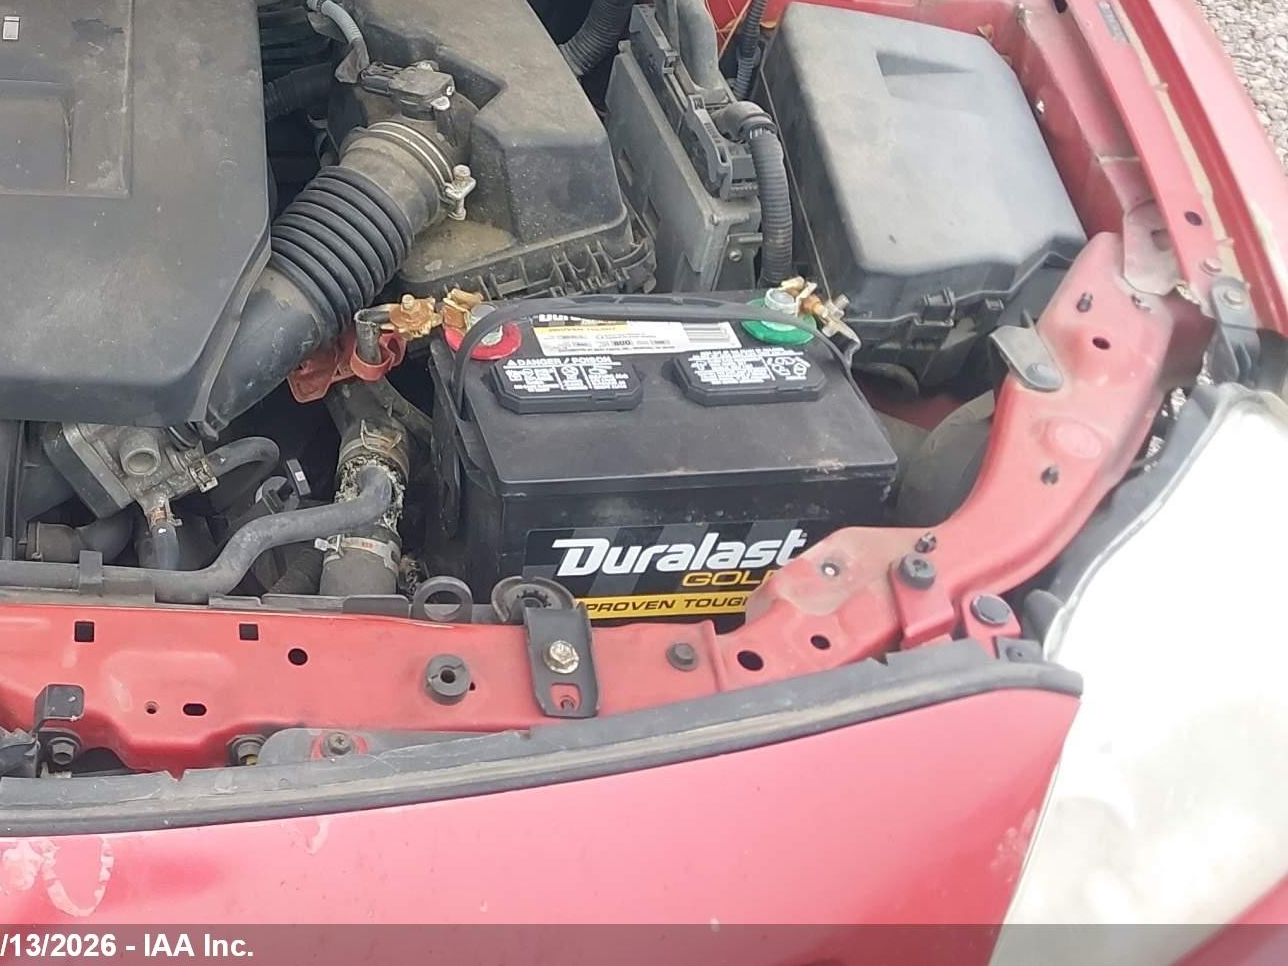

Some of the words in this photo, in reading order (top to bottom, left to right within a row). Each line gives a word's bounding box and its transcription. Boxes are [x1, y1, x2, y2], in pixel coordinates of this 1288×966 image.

[516, 357, 562, 367] DANGER
[571, 355, 612, 365] POISON
[551, 529, 807, 577] Duralast
[684, 596, 748, 609] TOUG
